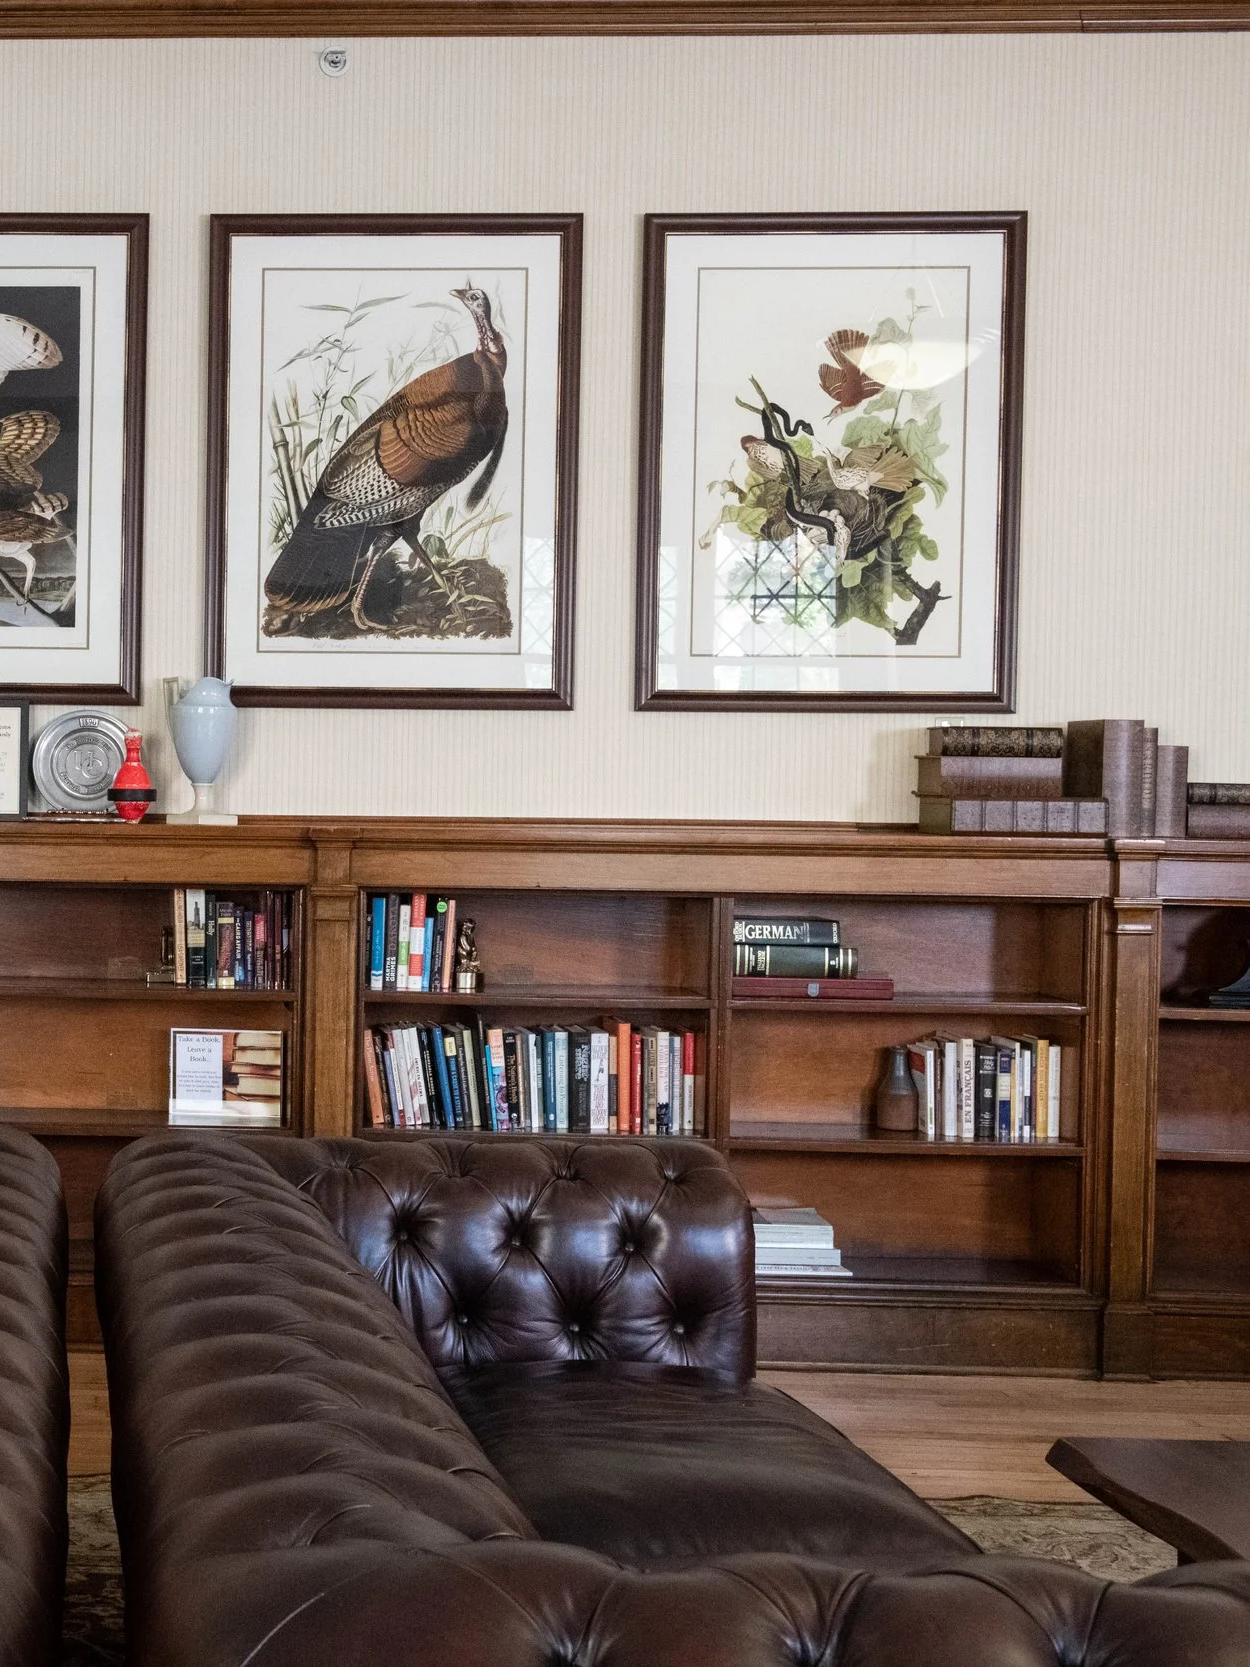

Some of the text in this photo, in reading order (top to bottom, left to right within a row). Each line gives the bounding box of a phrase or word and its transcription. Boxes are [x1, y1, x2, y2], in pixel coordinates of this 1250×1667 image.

[207, 920, 215, 936] Holly
[389, 907, 397, 950] DAKOTA
[745, 925, 804, 939] GERMAN
[557, 1055, 566, 1085] Listening
[574, 1048, 583, 1080] mare
[580, 1045, 590, 1081] Night-
[965, 1060, 973, 1124] EN FRANÇAIS
